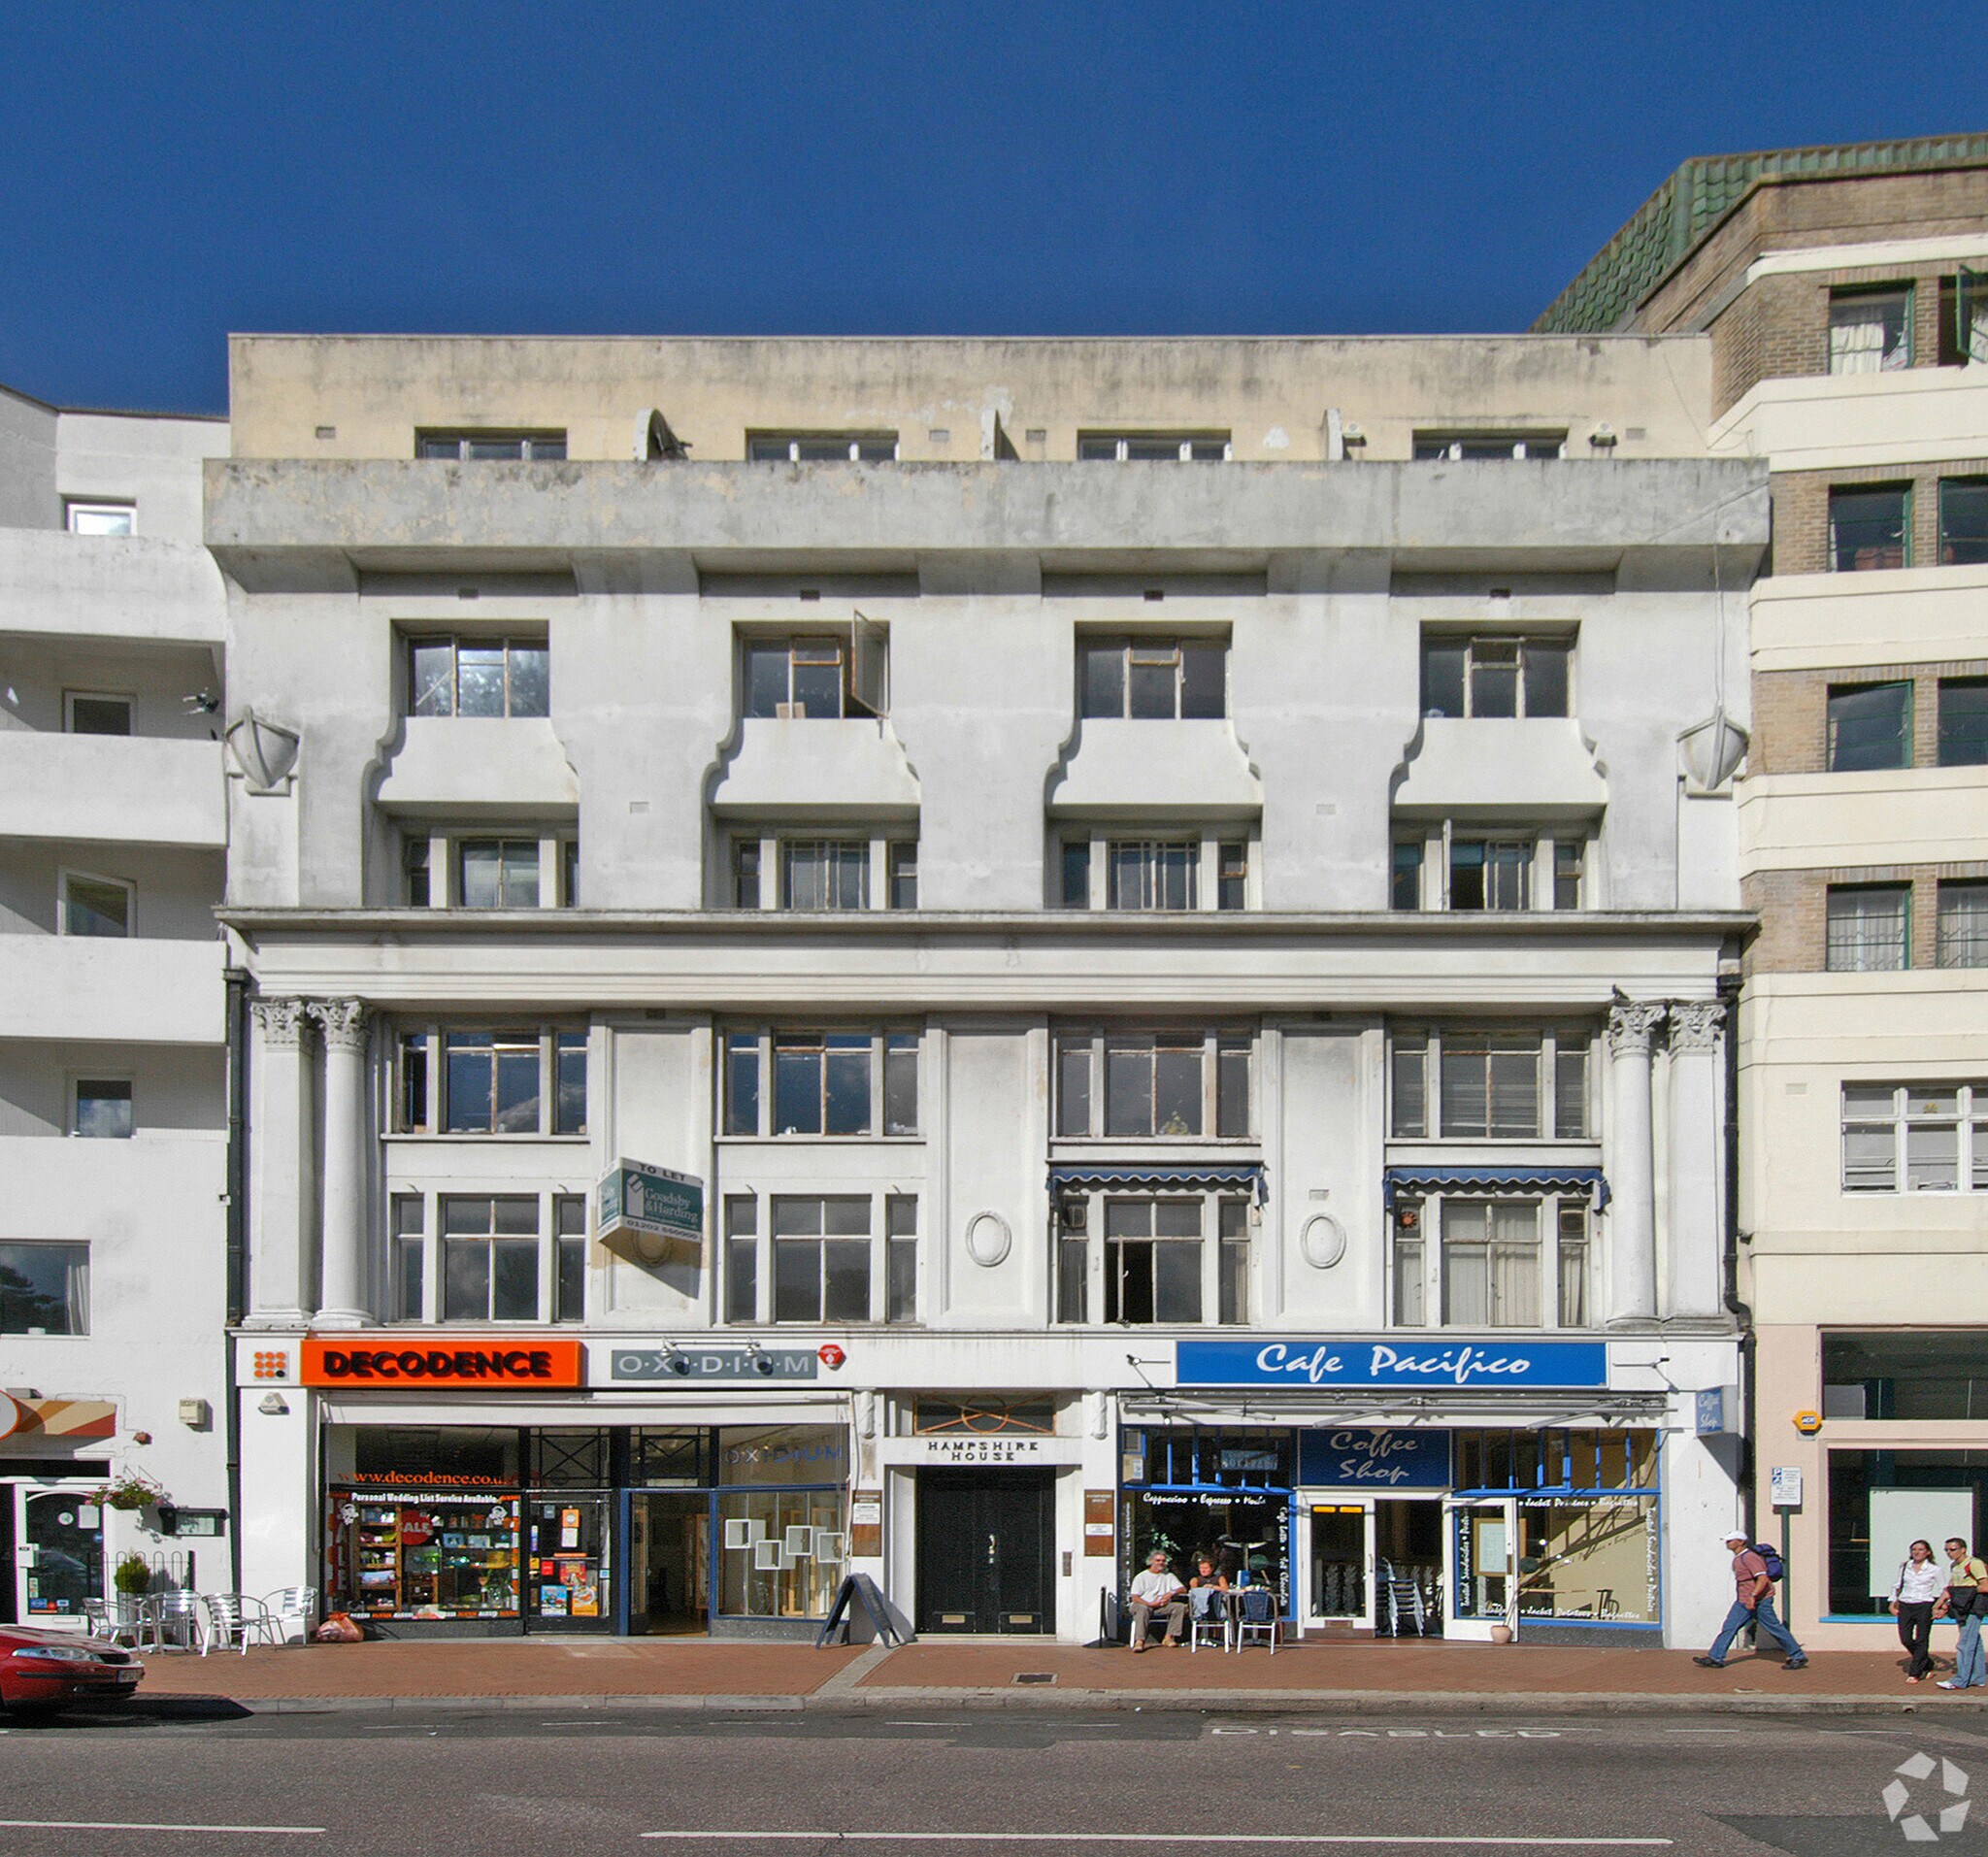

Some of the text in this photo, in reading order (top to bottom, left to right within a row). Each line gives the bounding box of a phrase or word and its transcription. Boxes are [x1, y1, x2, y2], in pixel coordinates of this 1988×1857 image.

[640, 1163, 686, 1181] TO LET
[323, 1350, 551, 1378] DECODENCE
[1255, 1343, 1531, 1384] Cafe Pacifico
[928, 1442, 1039, 1451] HAMPSHIRE
[1330, 1431, 1418, 1457] Coffee
[951, 1451, 1014, 1461] HOUSE
[1339, 1459, 1409, 1484] Shop
[351, 1492, 385, 1502] Personal
[386, 1493, 419, 1504] Wedding
[419, 1493, 435, 1503] List
[436, 1494, 462, 1504] Service
[400, 1522, 431, 1533] ALE
[1211, 1727, 1561, 1738] DISABLED
